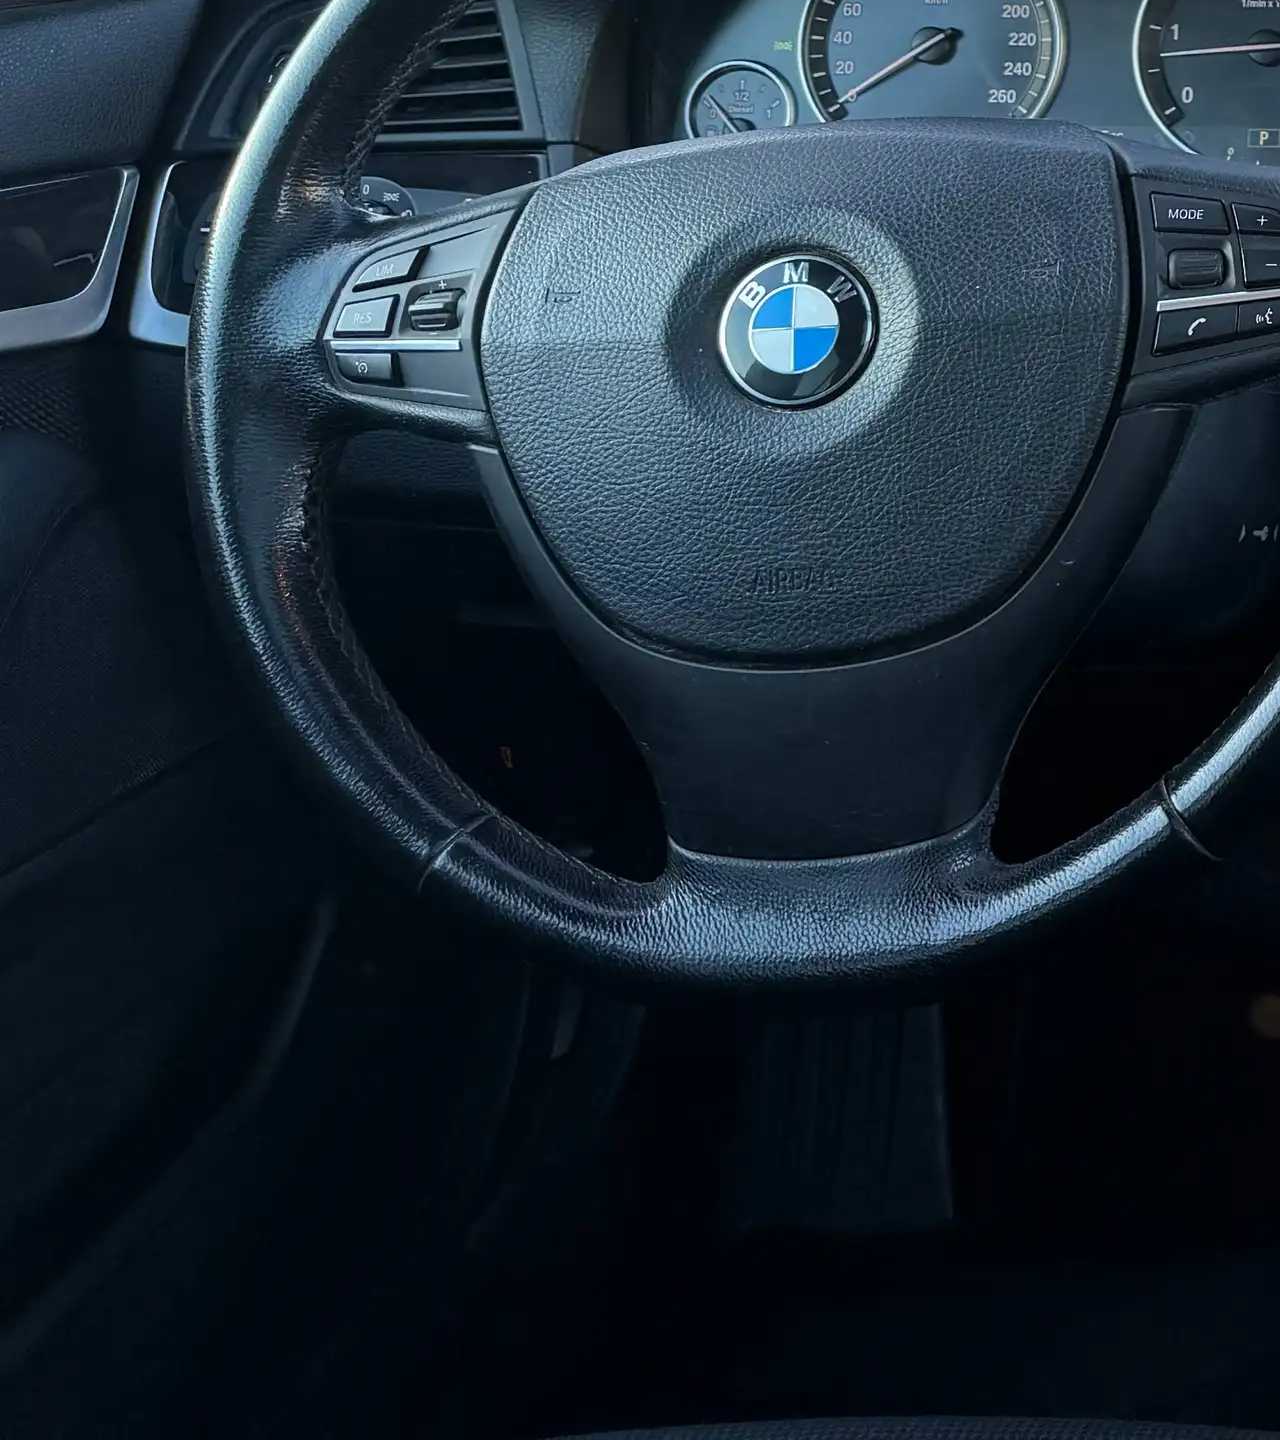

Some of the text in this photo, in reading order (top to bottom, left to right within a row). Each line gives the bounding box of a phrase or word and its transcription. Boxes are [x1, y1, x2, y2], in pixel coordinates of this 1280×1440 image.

[843, 3, 861, 17] 60
[1241, 0, 1266, 8] 1/min
[1002, 5, 1030, 18] 200
[833, 31, 852, 44] 40
[1170, 24, 1179, 41] 1
[1008, 33, 1037, 47] 220
[835, 61, 854, 75] 20
[1003, 62, 1032, 76] 240
[734, 92, 750, 102] 1/2
[988, 89, 1017, 103] 260
[1181, 87, 1193, 104] 0
[766, 109, 771, 119] 1
[1259, 131, 1269, 145] P
[1227, 147, 1235, 156] 0
[362, 184, 370, 195] 0
[1168, 208, 1204, 220] MODE
[375, 263, 395, 276] LIM
[738, 262, 858, 310] BMW
[352, 312, 372, 324] RES
